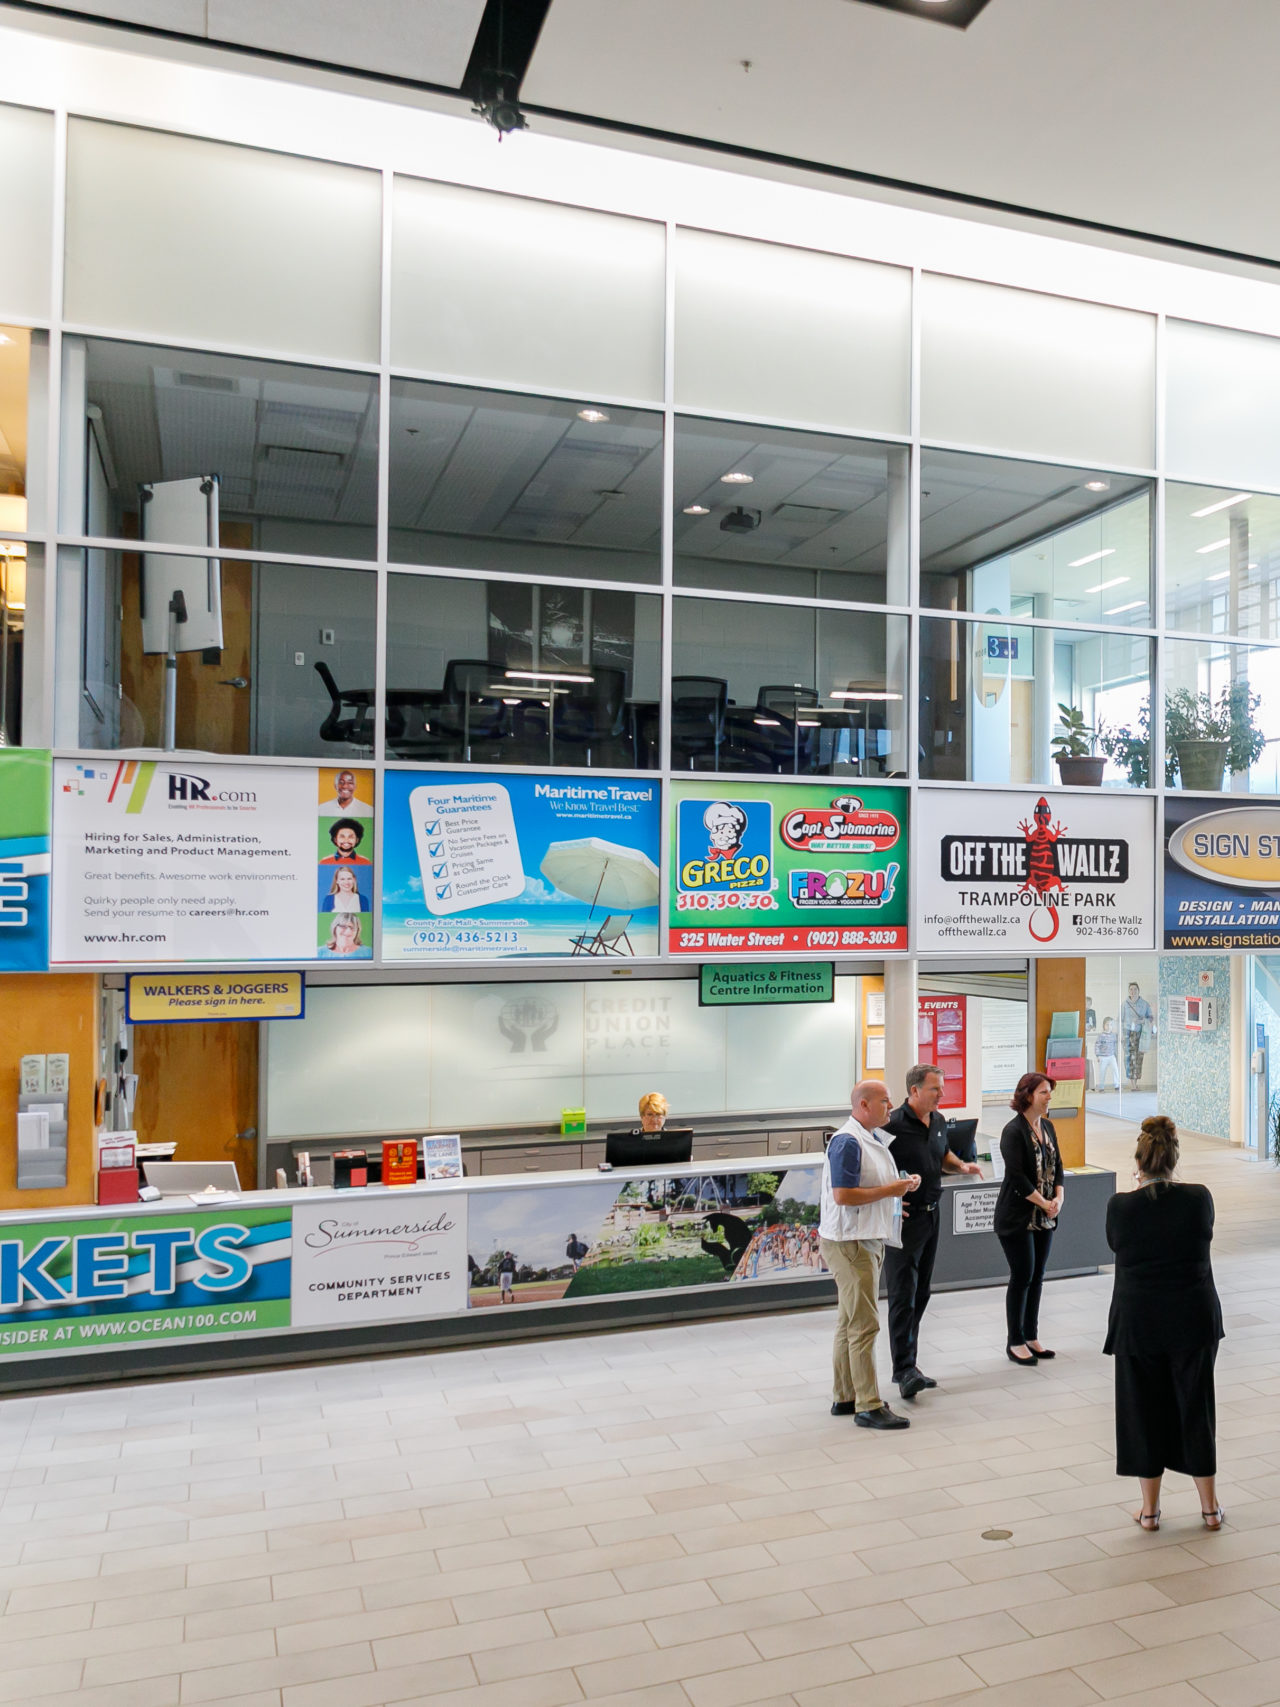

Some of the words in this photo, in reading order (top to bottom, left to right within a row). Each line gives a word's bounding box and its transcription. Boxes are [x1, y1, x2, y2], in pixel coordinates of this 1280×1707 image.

[160, 772, 256, 802] HR.com
[535, 784, 608, 800] Maritime
[608, 786, 652, 801] Travel
[428, 797, 450, 806] Four
[453, 794, 497, 804] Maritime
[436, 804, 492, 815] Guarantees
[550, 801, 564, 811] We
[565, 802, 588, 811] Know
[590, 802, 617, 812] Travel
[446, 826, 481, 834] Guarantee
[787, 814, 822, 839] Capt
[824, 815, 895, 838] Submarine
[85, 833, 120, 843] Hiring
[123, 833, 139, 842] for
[142, 833, 174, 843] Sales,
[176, 834, 262, 844] Administration,
[1194, 833, 1249, 858] SIGN
[85, 846, 144, 856] Marketing
[147, 846, 168, 855] and
[170, 847, 215, 856] Product
[218, 847, 292, 858] Management.
[950, 841, 987, 876] OFF
[988, 842, 1026, 877] THE
[1056, 844, 1120, 877] WALLZ
[84, 872, 112, 881] Great
[115, 872, 156, 881] benefits.
[159, 872, 207, 881] Awesome
[209, 872, 233, 881] work
[235, 873, 299, 881] environment.
[462, 866, 485, 875] Online
[682, 855, 769, 888] GRECO
[456, 880, 478, 889] Round
[492, 874, 511, 882] Clock
[457, 886, 490, 896] Customer
[84, 896, 117, 906] Quirky
[120, 896, 155, 906] people
[157, 896, 178, 906] only
[181, 896, 206, 905] need
[208, 896, 237, 906] apply.
[958, 891, 1070, 907] TRAMPOLINE
[1074, 892, 1116, 907] PARK
[1179, 901, 1232, 912] DESIGN
[84, 909, 110, 917] Send
[112, 910, 134, 919] your
[176, 909, 187, 917] to
[189, 908, 270, 917] careers@hr.com
[924, 914, 1021, 925] info@offthewallz.ca
[406, 920, 435, 928] County
[1084, 915, 1099, 925] Off
[1100, 915, 1117, 925] The
[1118, 915, 1143, 925] Wallz
[1178, 915, 1279, 926] INSTALLATION
[84, 933, 167, 943] www.hr.com
[938, 927, 1007, 937] offthewallz.ca
[1076, 927, 1139, 937] 902-436-8760
[413, 932, 451, 945] (902)
[455, 932, 518, 943] 436-5213
[680, 932, 704, 947] 325
[707, 932, 744, 947] Water
[747, 932, 785, 946] Street
[806, 931, 838, 947] (902)
[842, 931, 897, 945] 888-3030
[713, 971, 765, 984] Aquatics
[768, 971, 777, 981] &
[780, 970, 822, 981] Fitness
[144, 984, 210, 997] WALKERS
[213, 984, 224, 995] &
[226, 983, 289, 995] JOGGERS
[710, 985, 750, 996] Centre
[753, 983, 824, 995] Information
[168, 997, 202, 1007] Please
[204, 997, 226, 1008] sign
[228, 996, 238, 1005] in
[240, 996, 265, 1005] here.
[586, 997, 672, 1014] CREDIT
[924, 1001, 959, 1009] EVENTS
[586, 1015, 670, 1033] UNION
[586, 1035, 671, 1050] PLACE
[304, 1212, 456, 1248] Summerside
[309, 1277, 385, 1292] COMMUNITY
[390, 1271, 451, 1285] SERVICES
[338, 1286, 423, 1302] DEPARTMENT
[0, 1329, 48, 1345] SIDER
[54, 1326, 74, 1341] AT
[80, 1310, 257, 1338] WWW.OCEAN100.COM
